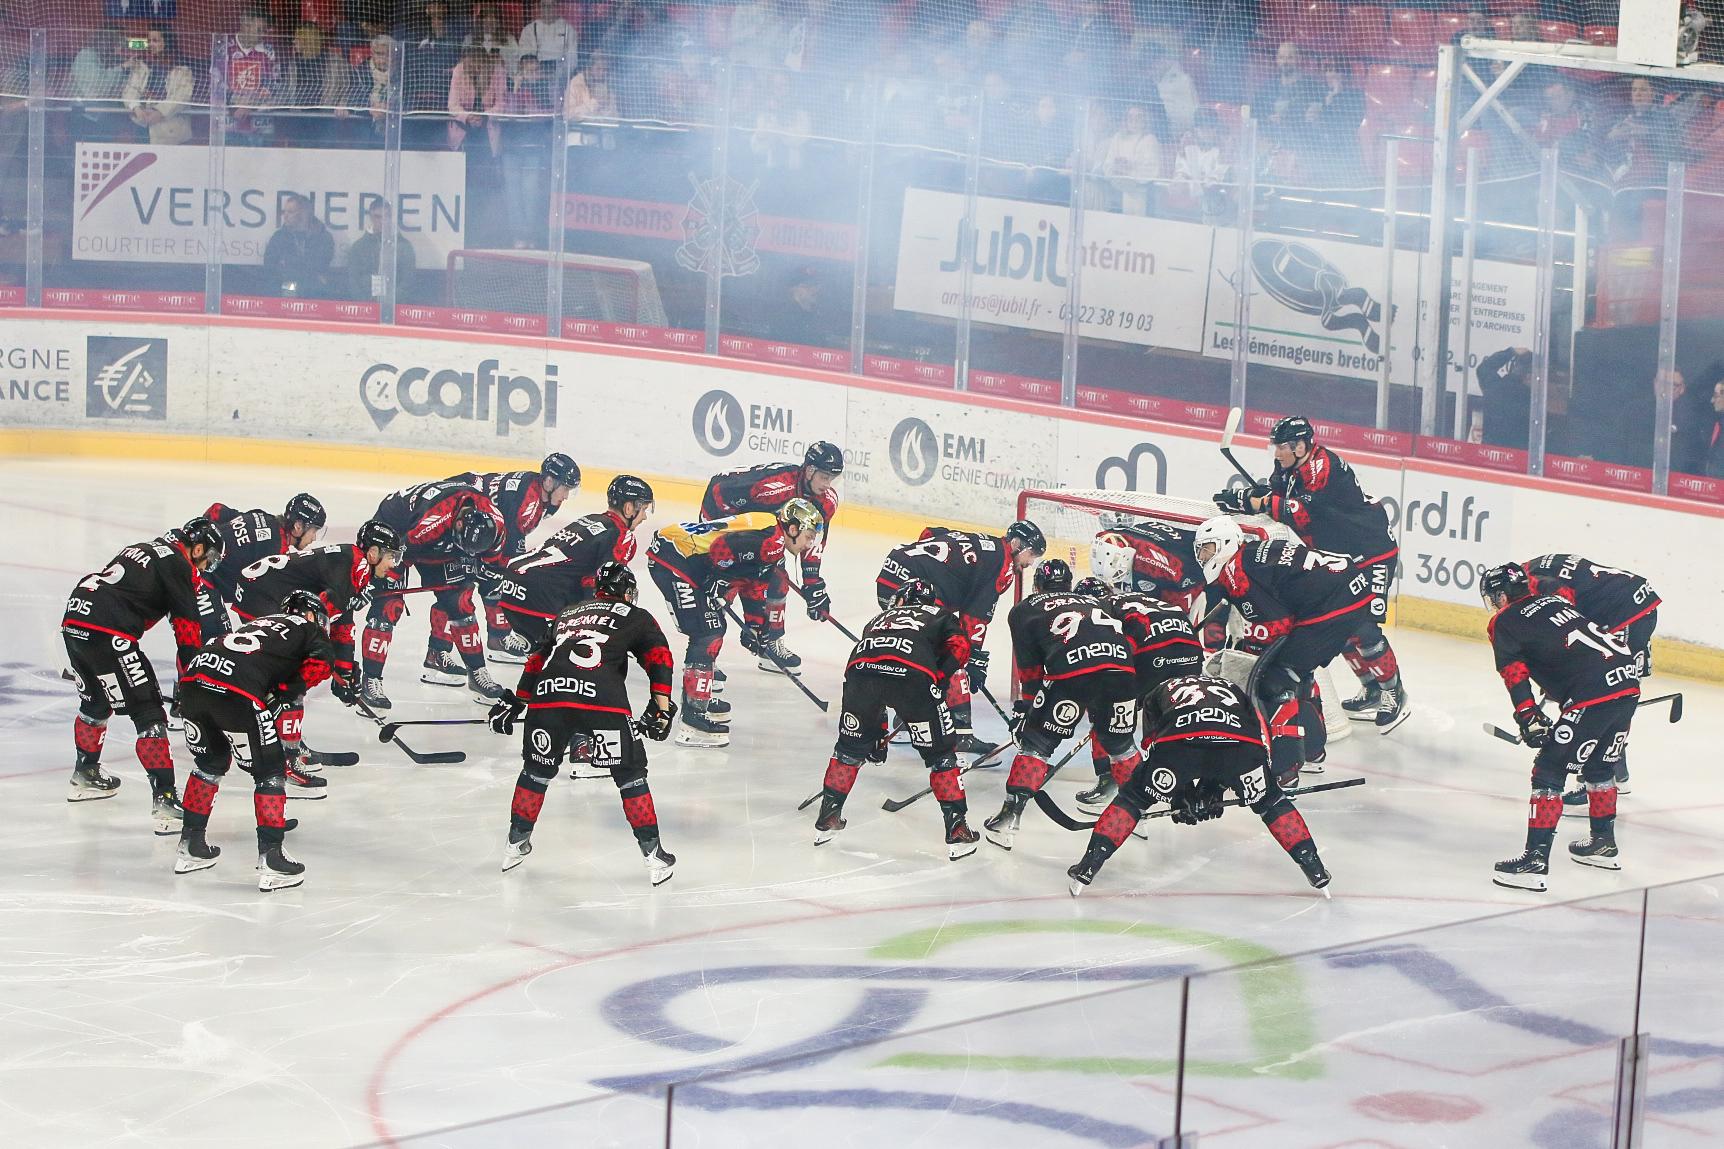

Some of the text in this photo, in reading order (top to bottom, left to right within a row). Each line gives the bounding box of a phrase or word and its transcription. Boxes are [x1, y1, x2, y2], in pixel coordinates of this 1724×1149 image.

[77, 236, 176, 256] COURTIER
[1097, 307, 1114, 327] 38
[1119, 310, 1134, 330] 19
[1136, 313, 1154, 332] 03
[1470, 307, 1526, 322] 'ENTREPRISES
[1244, 335, 1334, 366] éménageurs
[1337, 349, 1392, 374] breto
[749, 404, 793, 434] EMI
[748, 431, 872, 468] GÉNIE CLQUE
[943, 432, 986, 464] EMI
[1371, 564, 1386, 594] EMI
[1415, 553, 1487, 590] 360°
[676, 581, 697, 609] EMI
[1050, 608, 1123, 643] 94
[123, 651, 149, 687] EMI
[259, 709, 279, 746] EMI
[940, 701, 955, 735] EMI
[1043, 721, 1073, 736] RIVERY
[531, 753, 556, 766] RIVERY
[1144, 786, 1173, 804] RIVERY
